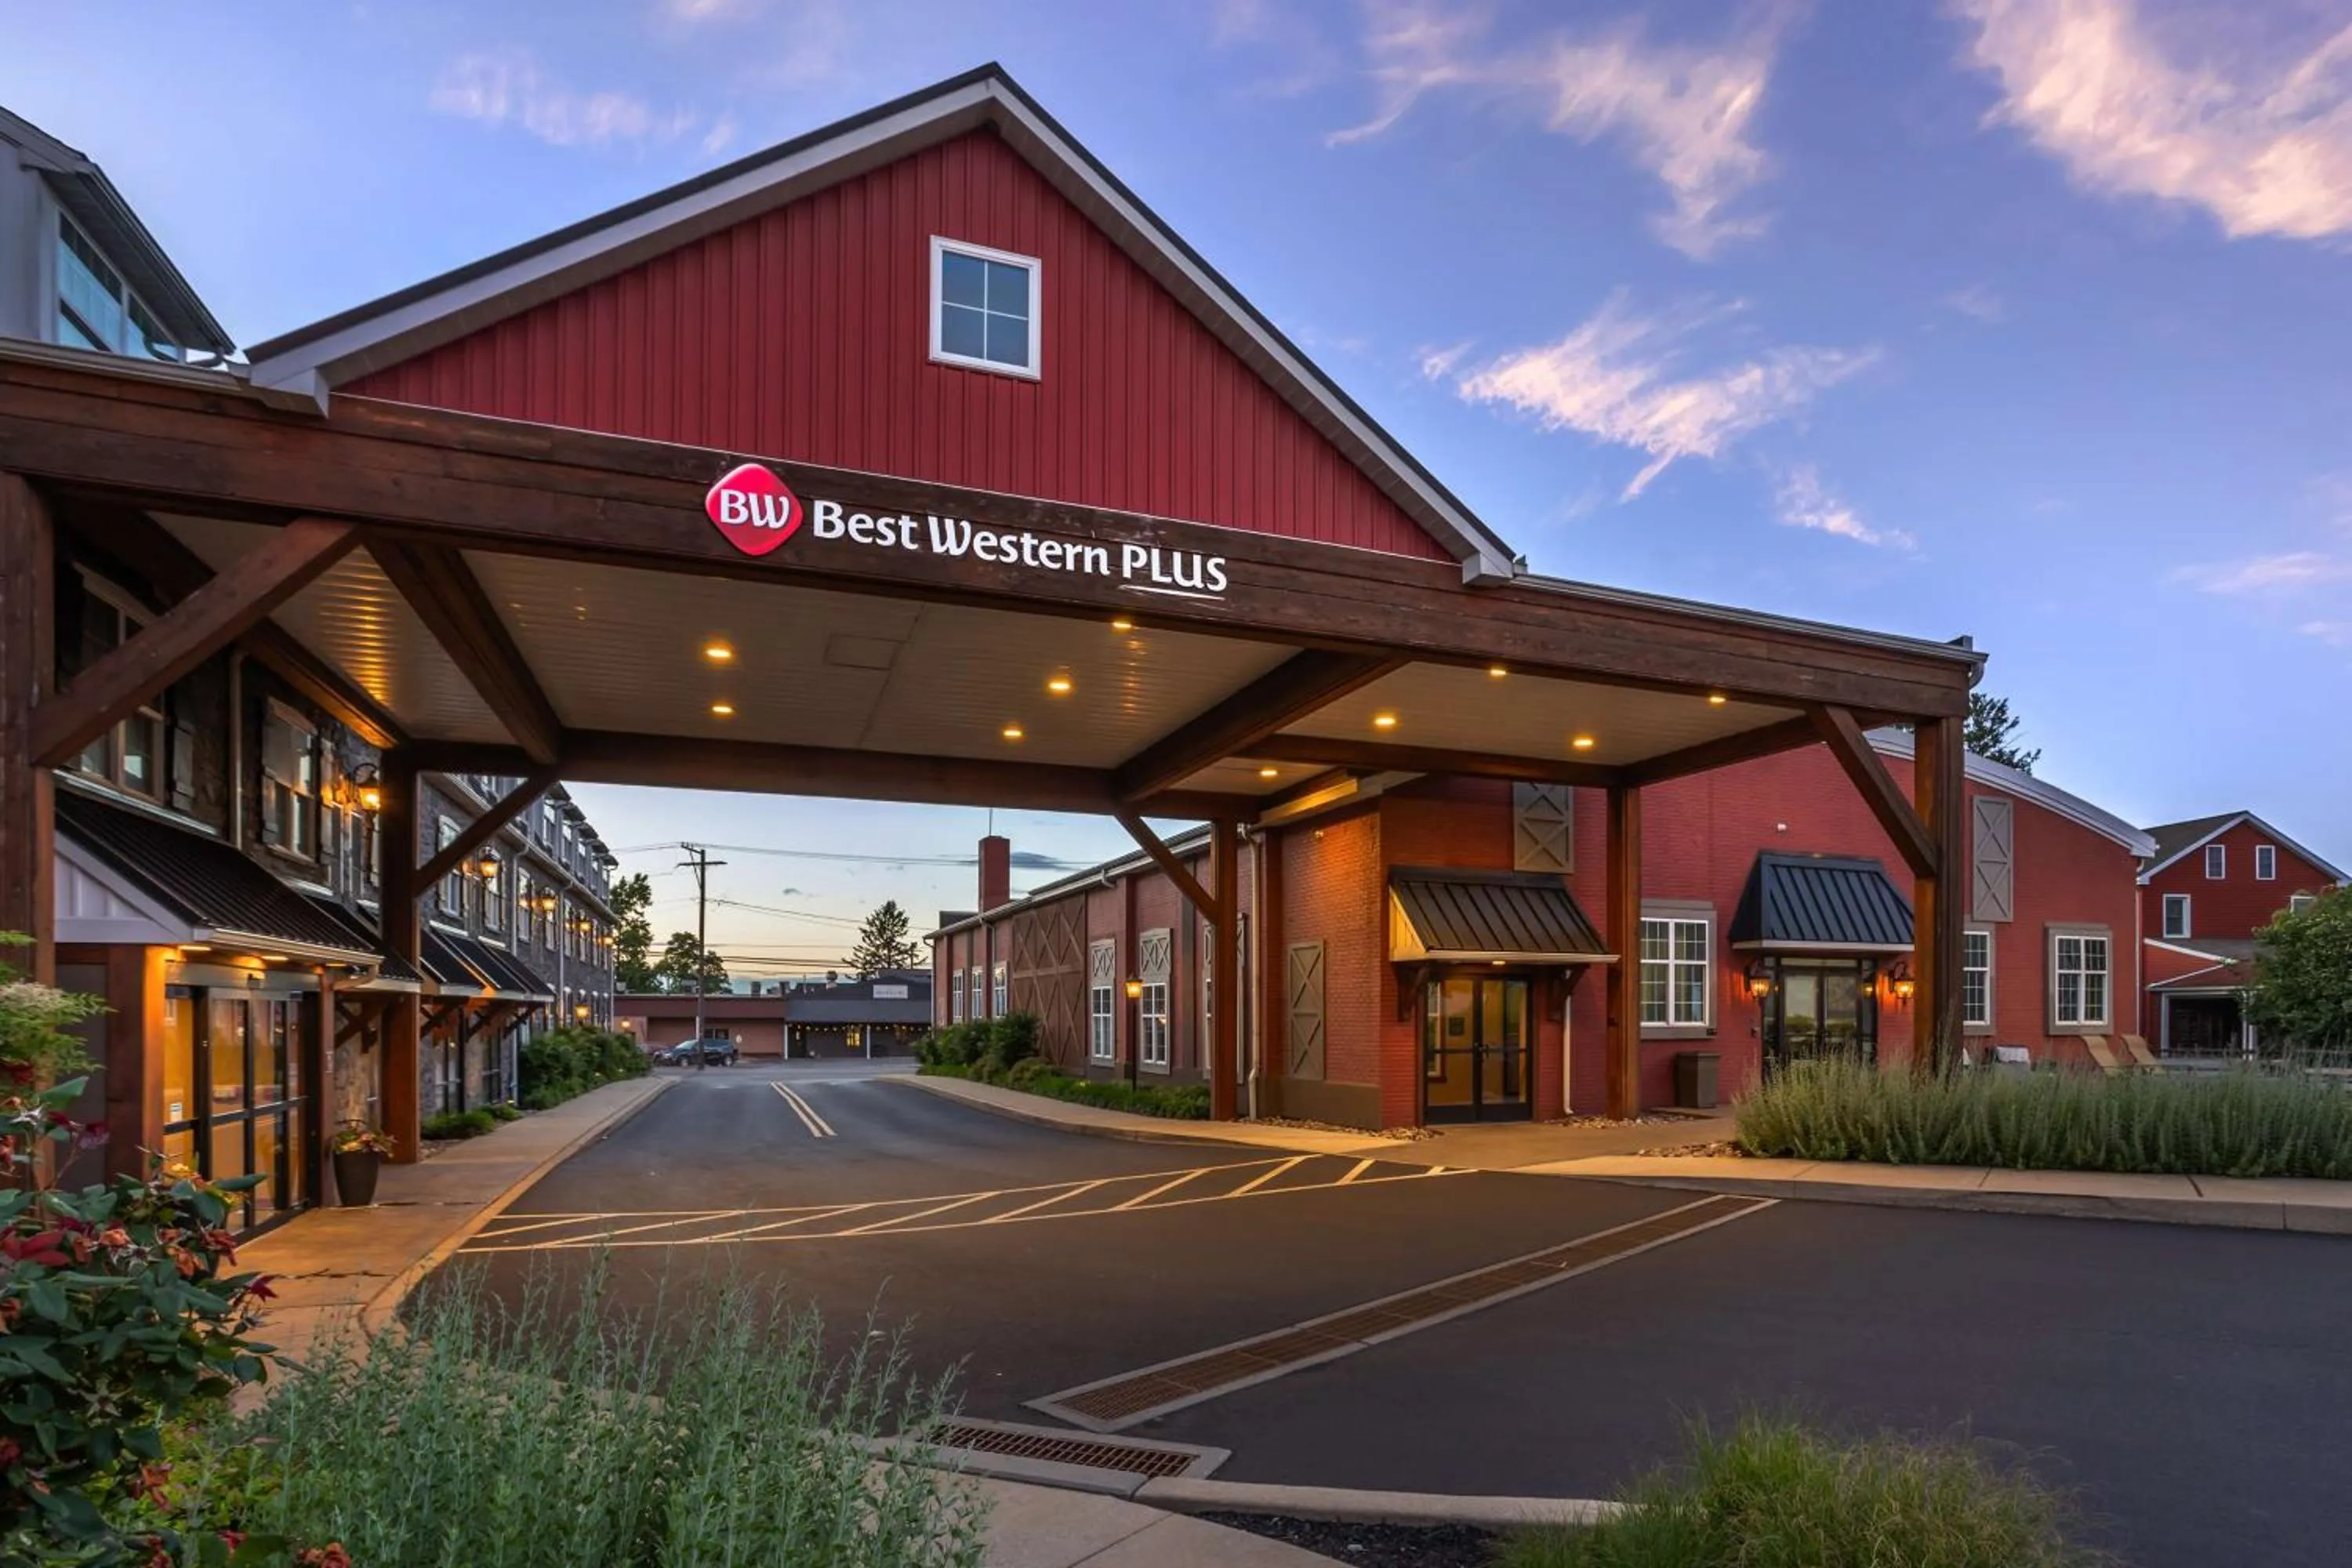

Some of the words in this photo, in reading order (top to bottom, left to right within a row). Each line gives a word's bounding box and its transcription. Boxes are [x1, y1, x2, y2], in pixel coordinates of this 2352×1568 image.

[719, 488, 790, 530] BW
[812, 499, 919, 550] Best
[927, 514, 1111, 576] Western
[1121, 543, 1228, 593] PLUS
